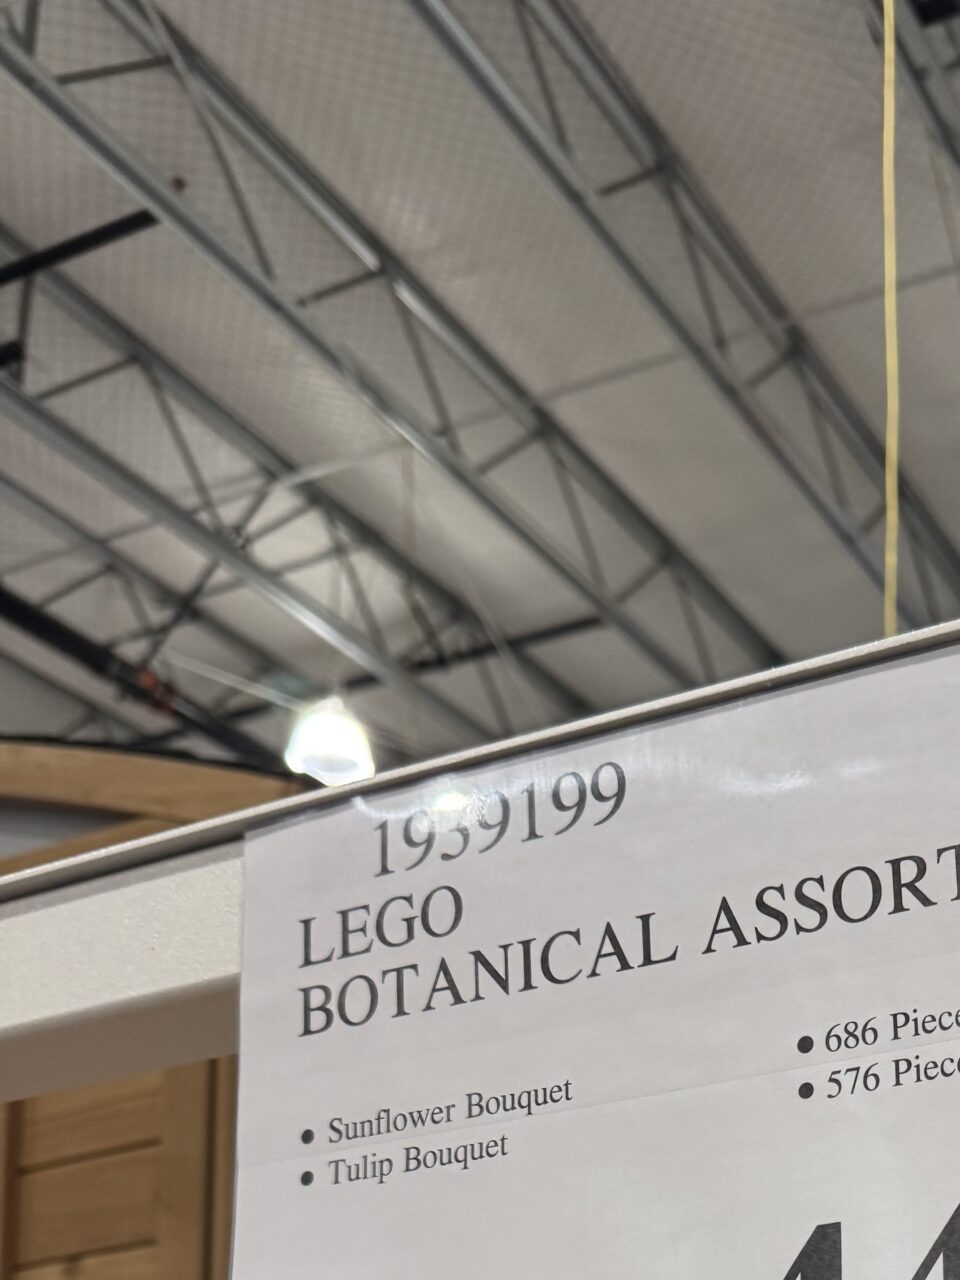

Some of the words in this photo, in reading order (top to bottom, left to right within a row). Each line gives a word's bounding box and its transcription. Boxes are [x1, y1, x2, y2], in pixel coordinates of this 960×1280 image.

[298, 885, 464, 969] LEGO
[297, 911, 680, 1038] BOTANICAL
[824, 1016, 879, 1053] 686
[826, 1062, 881, 1099] 576
[328, 1103, 456, 1144] Sunflower
[465, 1079, 574, 1120] Bouquet
[327, 1154, 394, 1185] Tulip
[402, 1134, 509, 1173] Bouquet
